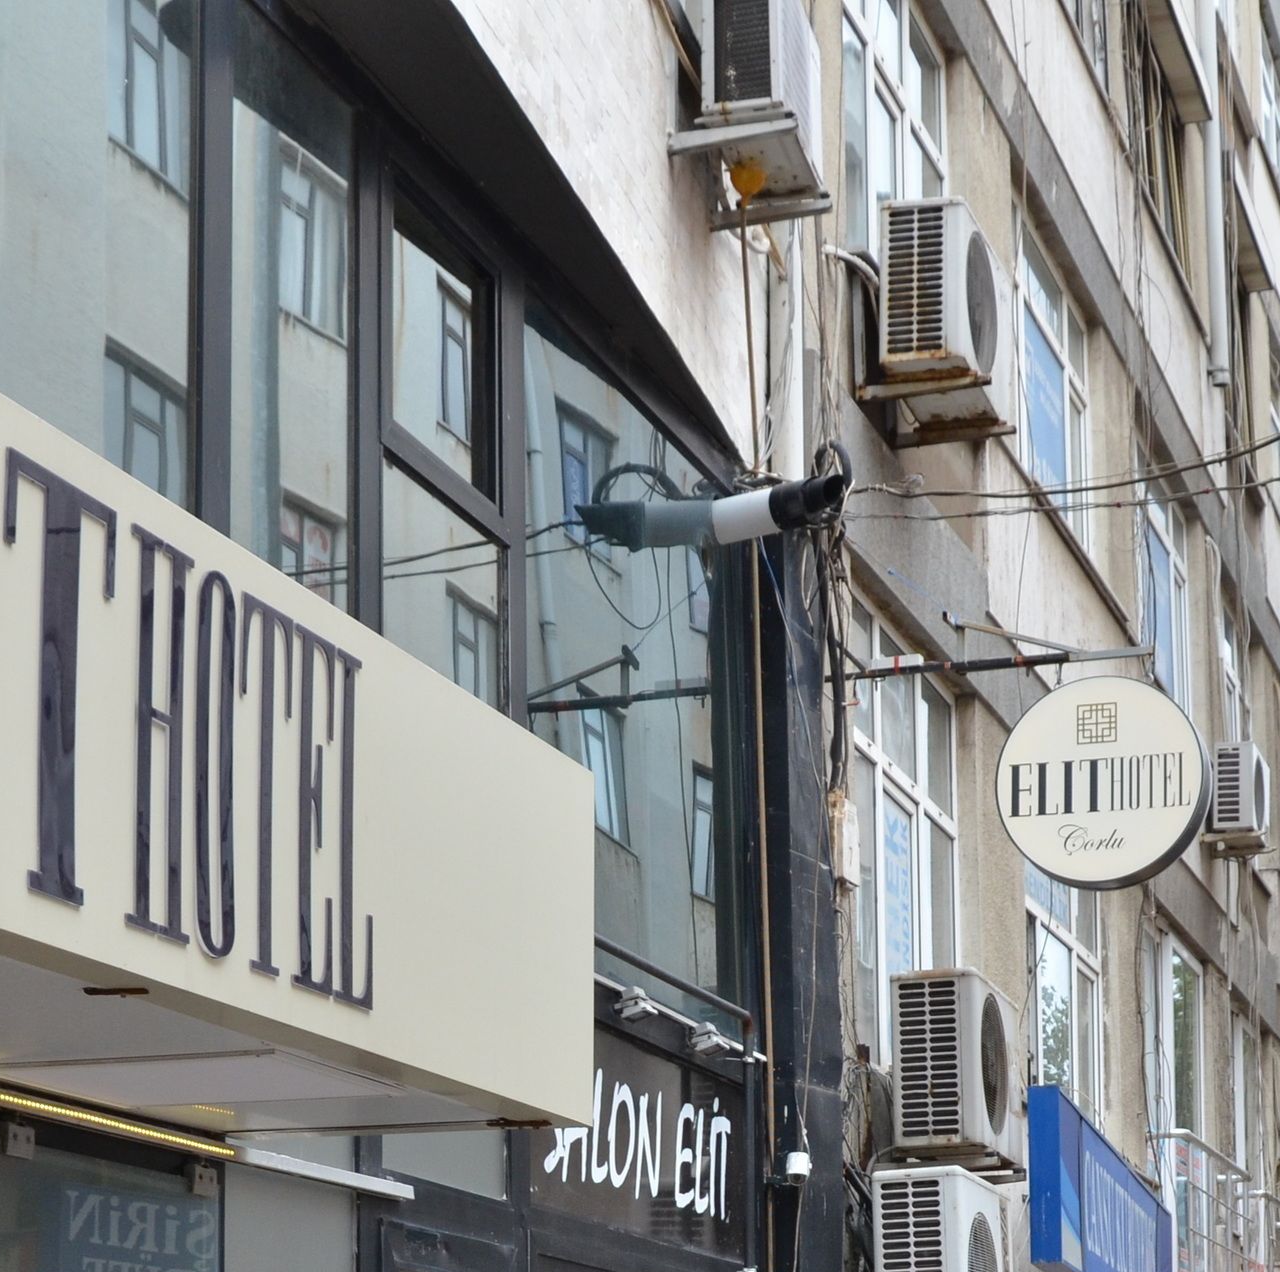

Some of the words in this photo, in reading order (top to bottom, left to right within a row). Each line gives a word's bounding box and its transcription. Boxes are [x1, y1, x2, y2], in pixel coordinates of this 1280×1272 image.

[125, 522, 374, 1011] HOTEL
[1008, 757, 1109, 818] ELIT
[1109, 751, 1191, 812] HOTEL
